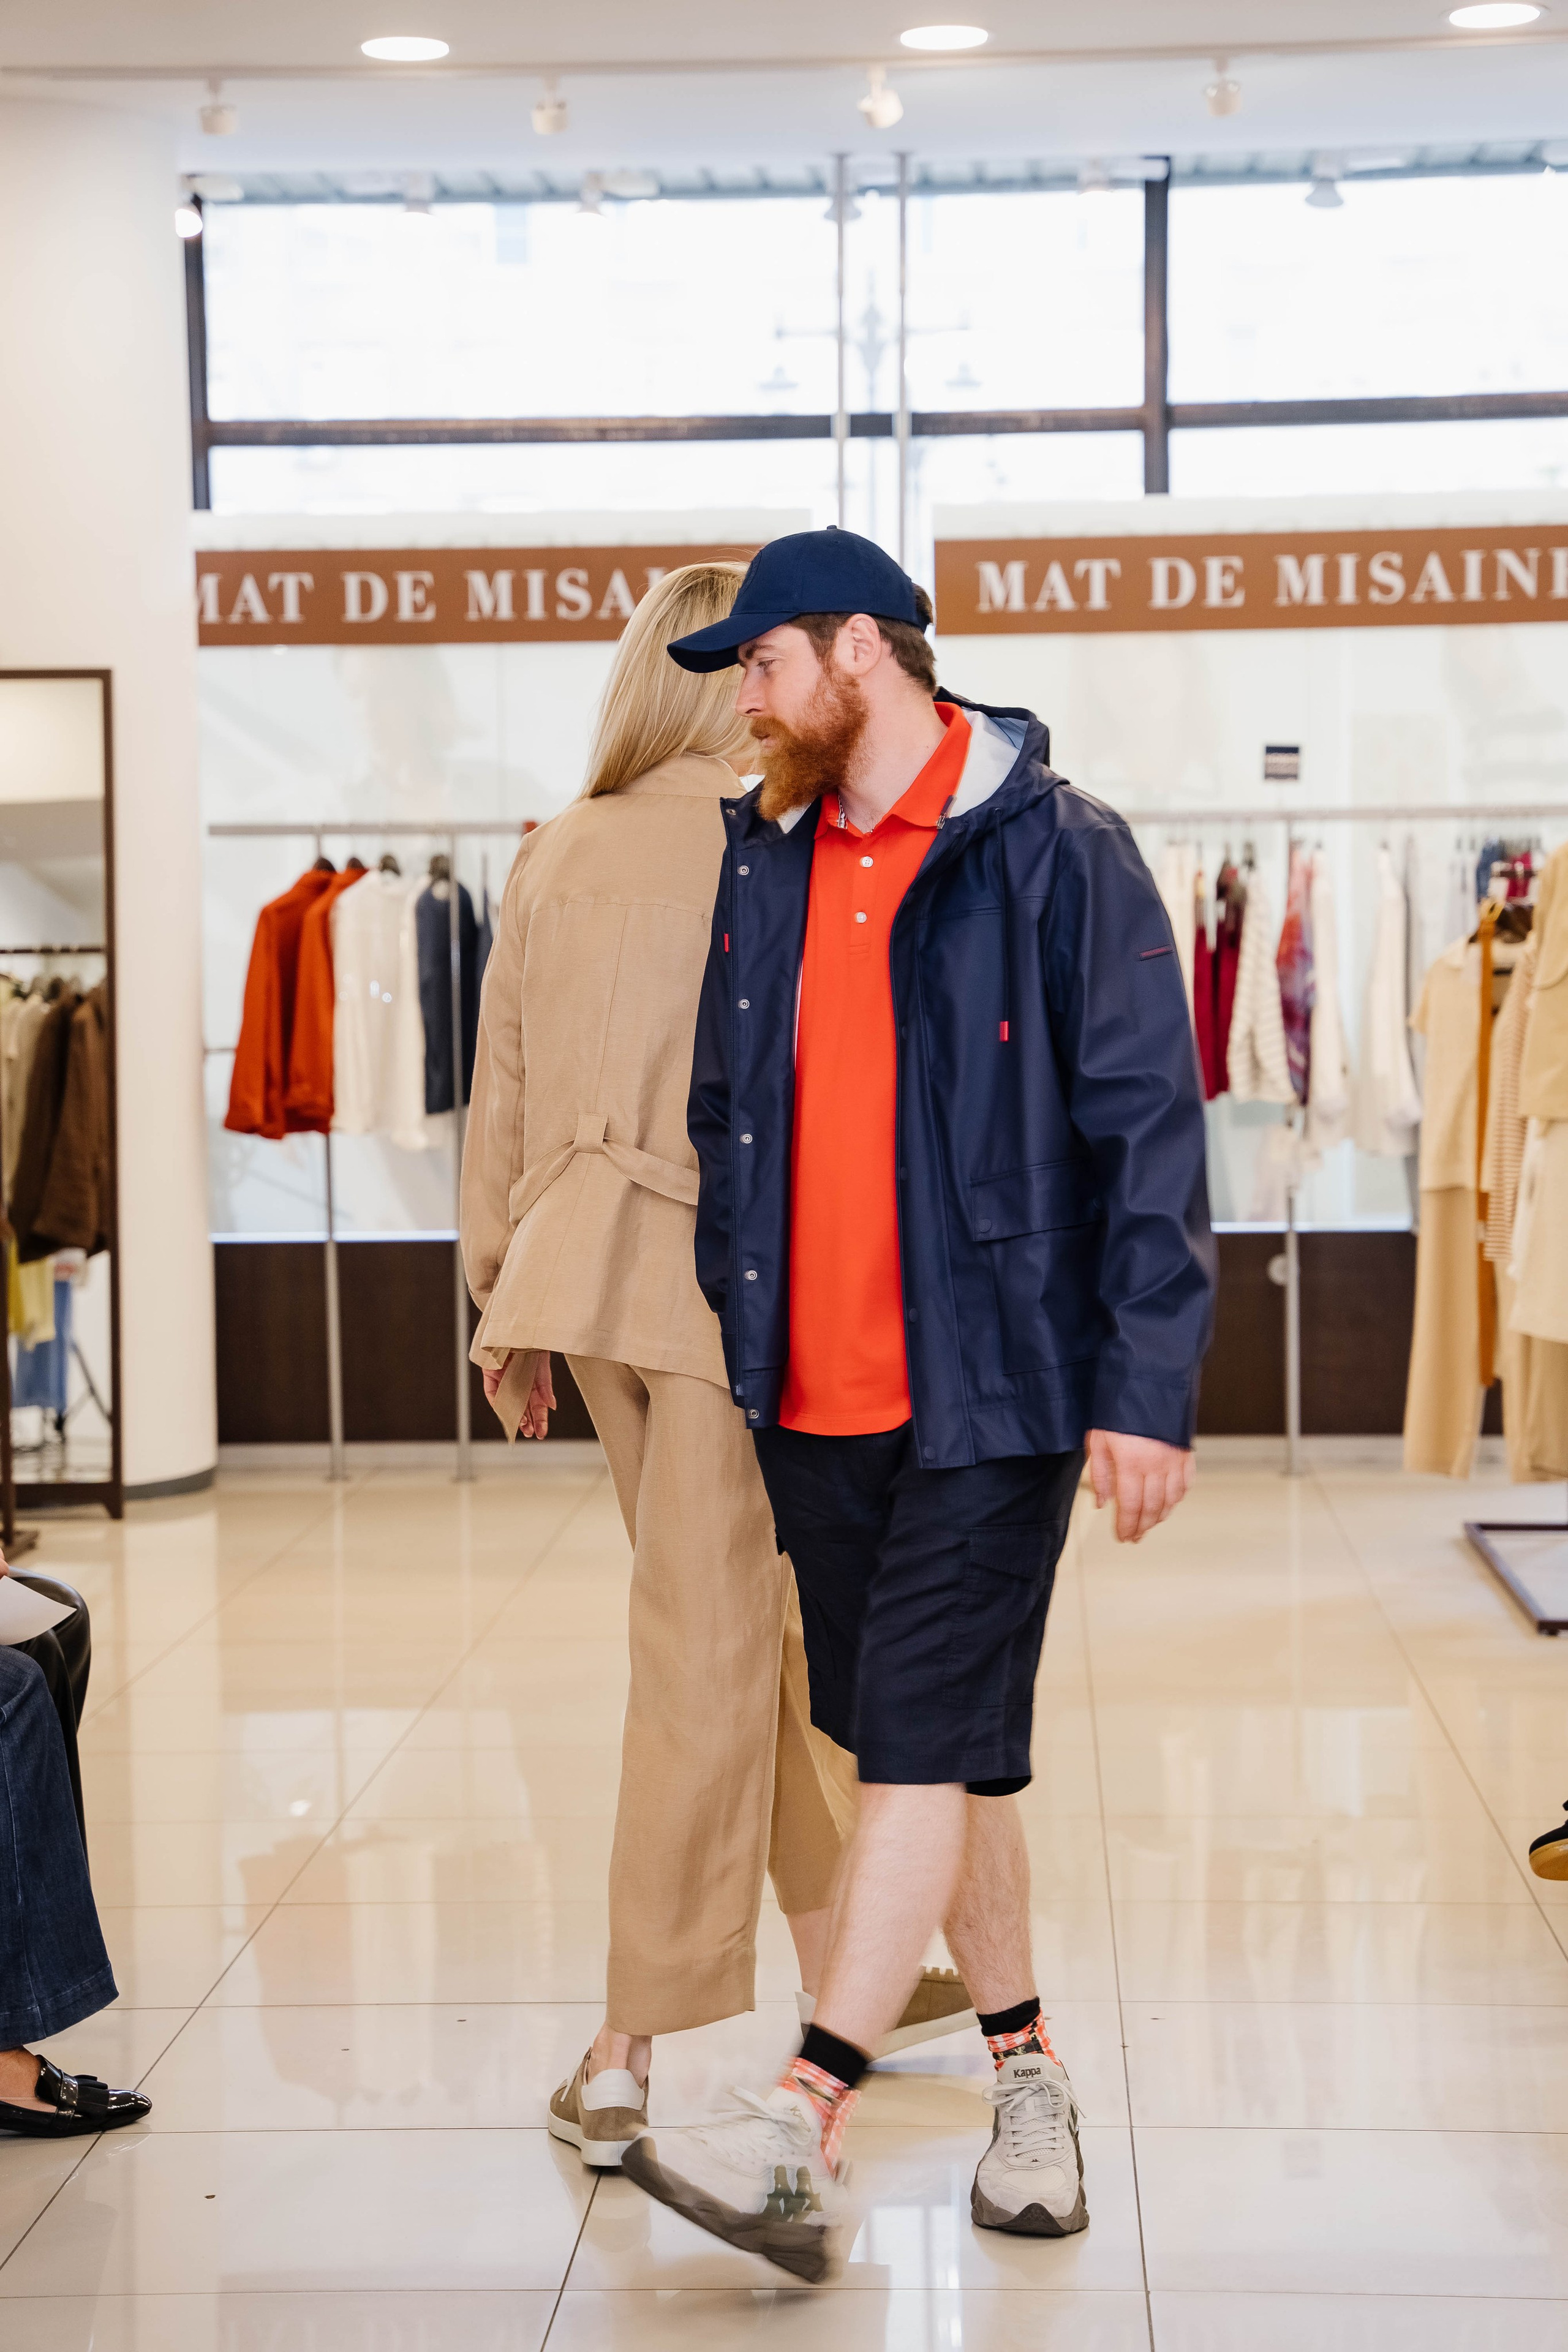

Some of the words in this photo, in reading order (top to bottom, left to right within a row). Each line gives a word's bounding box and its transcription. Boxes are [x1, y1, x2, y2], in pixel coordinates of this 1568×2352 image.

[341, 570, 437, 623] DE
[974, 557, 1121, 612] MAT
[1147, 555, 1246, 609] DE
[1013, 2067, 1041, 2078] Kappa
